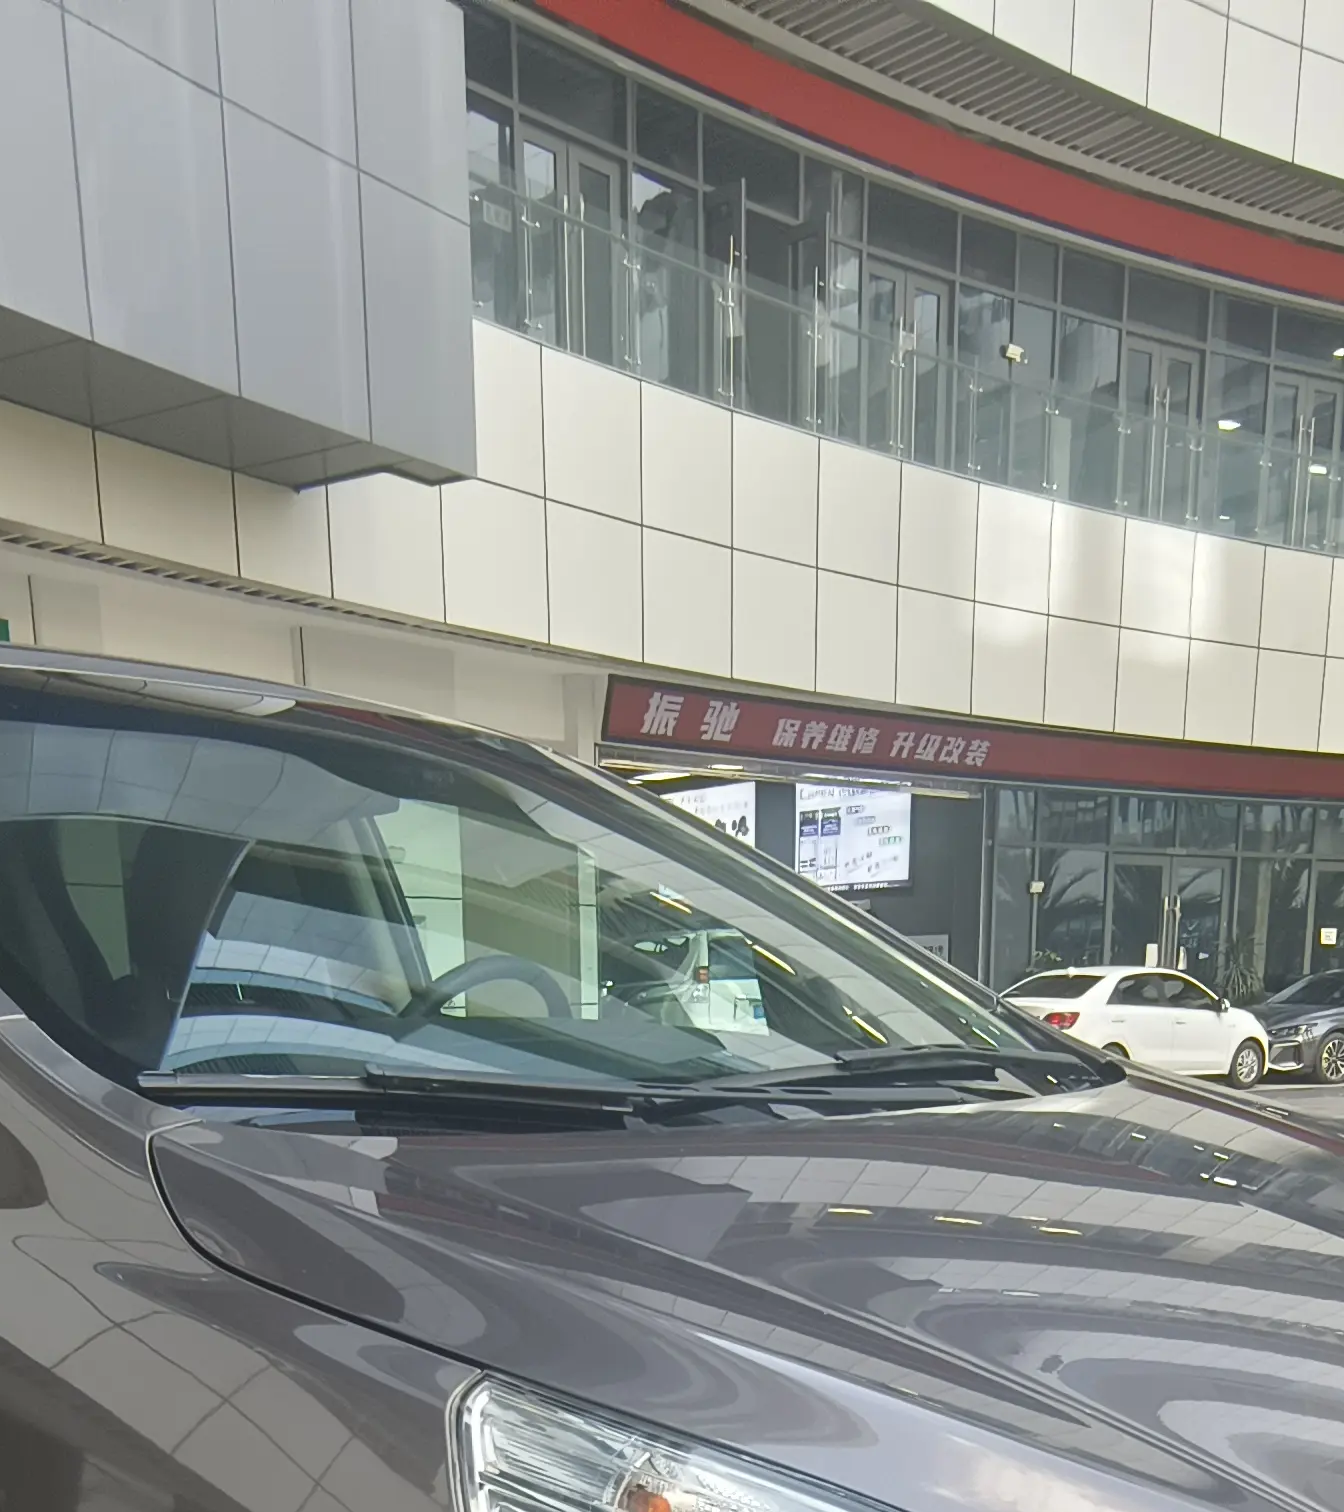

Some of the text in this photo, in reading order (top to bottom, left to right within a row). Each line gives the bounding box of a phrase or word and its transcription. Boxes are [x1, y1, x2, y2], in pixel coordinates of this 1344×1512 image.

[772, 718, 880, 755] 保养维修
[889, 731, 991, 767] 升级改装
